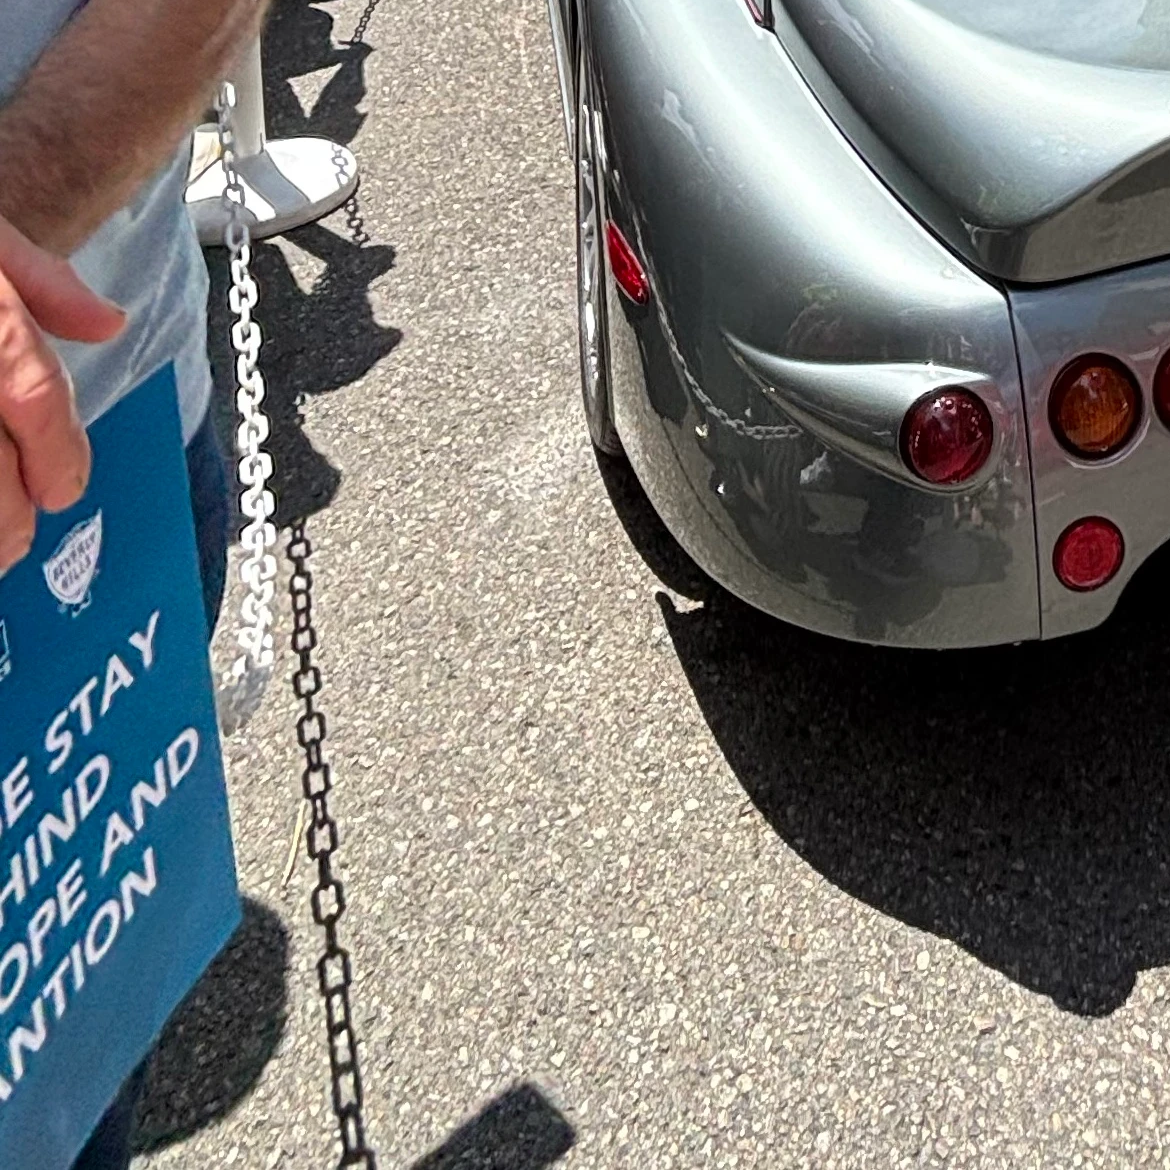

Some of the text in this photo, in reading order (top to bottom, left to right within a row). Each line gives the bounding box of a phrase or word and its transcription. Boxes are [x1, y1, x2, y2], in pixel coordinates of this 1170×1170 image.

[0, 609, 161, 837] E STAY
[0, 726, 200, 1016] OPE AND
[0, 845, 158, 1102] NTION
